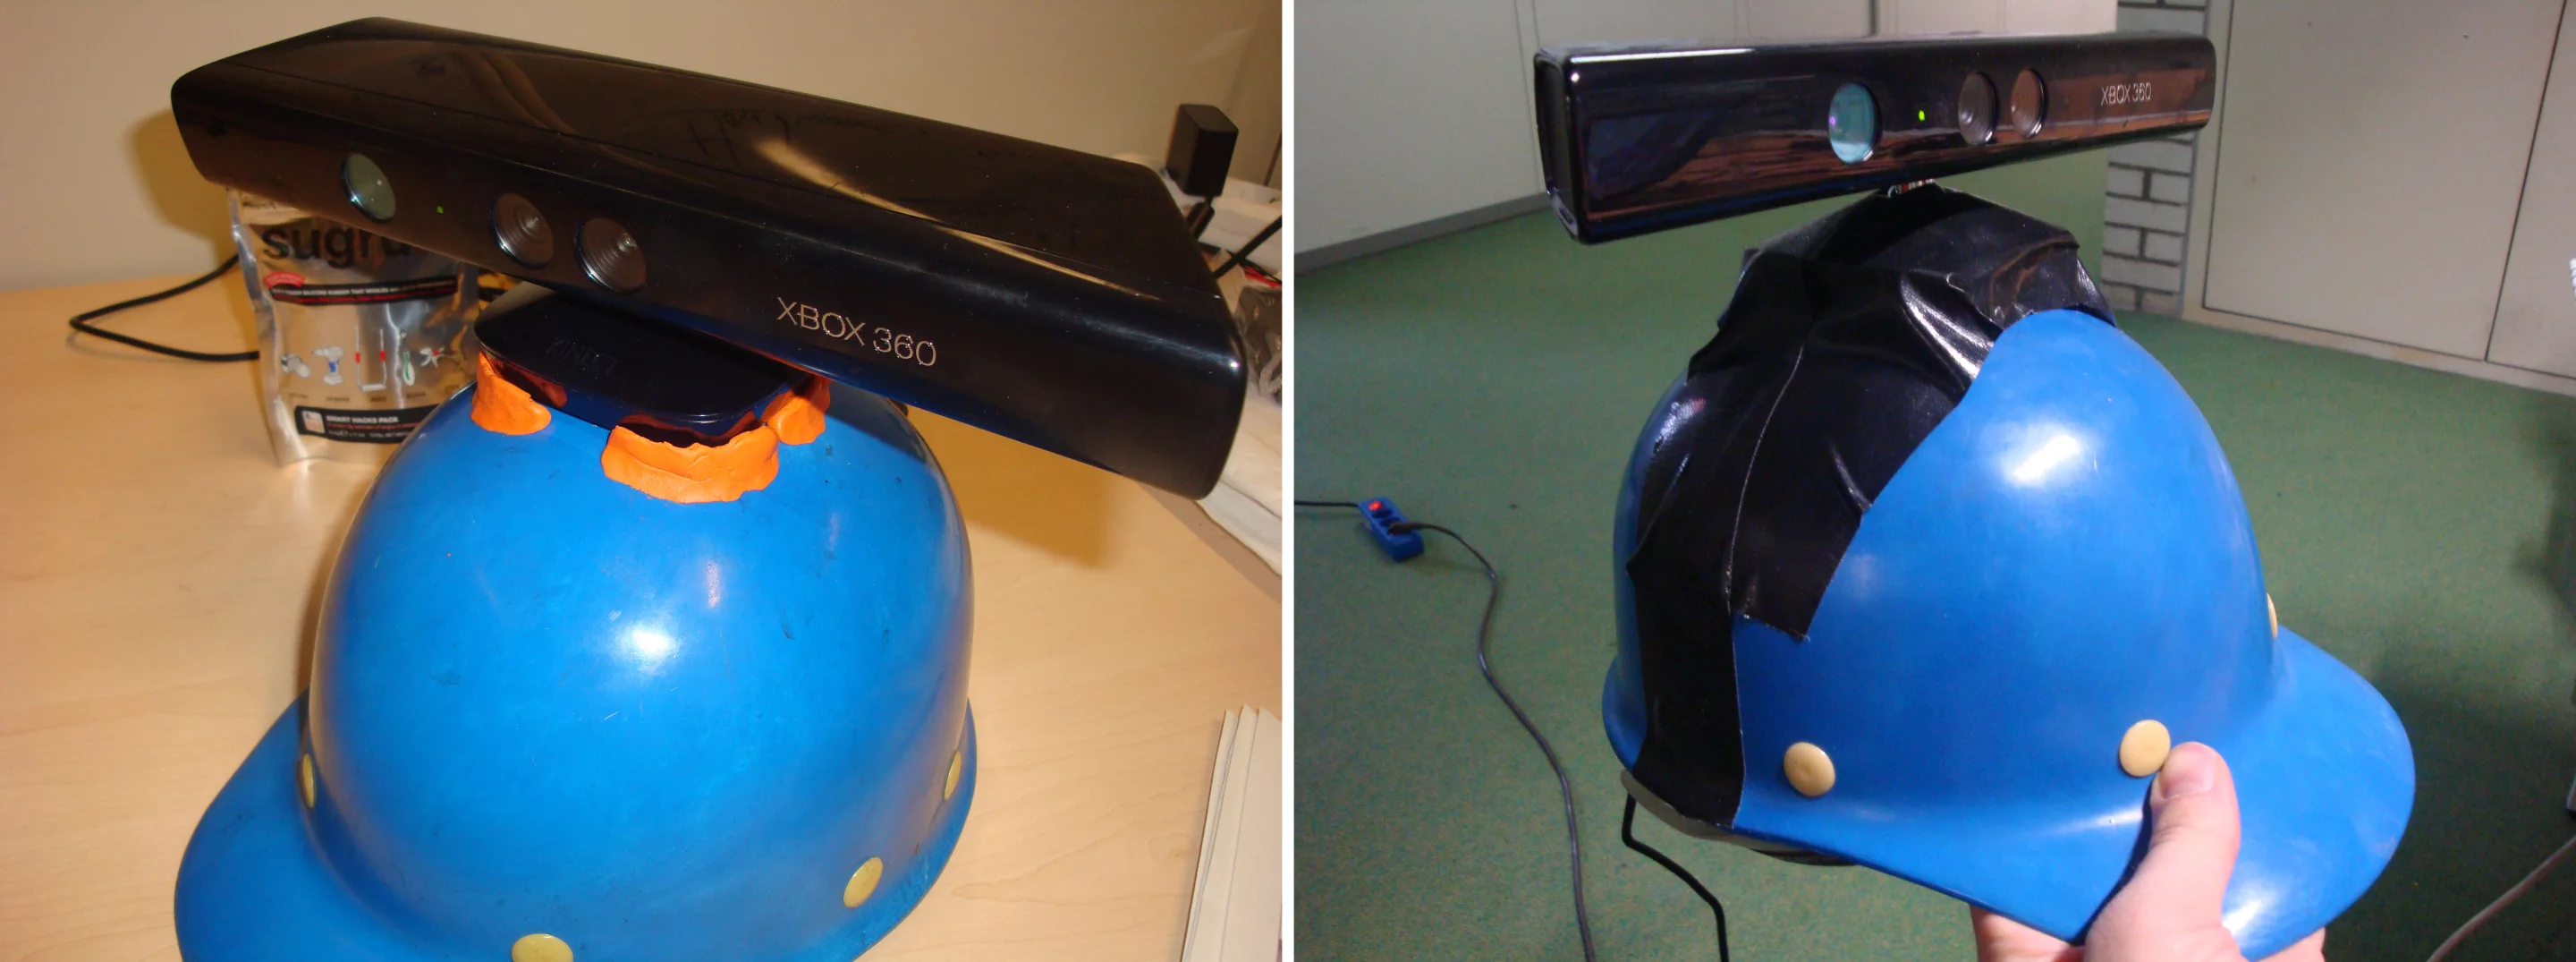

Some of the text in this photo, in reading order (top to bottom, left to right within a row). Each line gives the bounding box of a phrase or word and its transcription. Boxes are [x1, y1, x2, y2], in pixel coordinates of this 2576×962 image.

[2100, 81, 2152, 106] XBOX 360
[776, 296, 937, 368] XBOX 360
[377, 415, 400, 423] PACK
